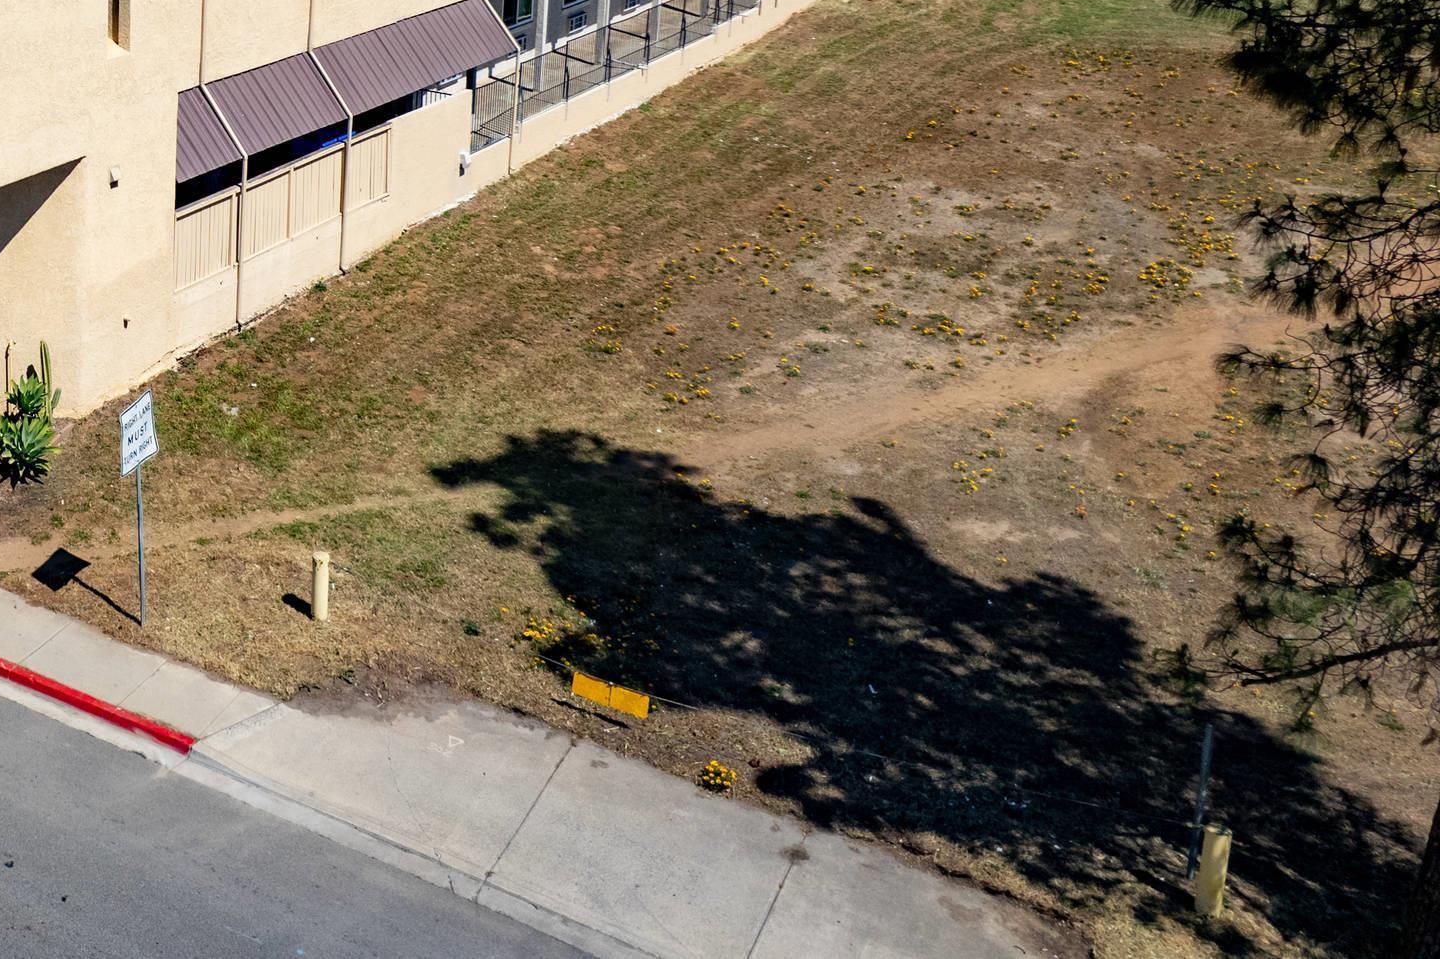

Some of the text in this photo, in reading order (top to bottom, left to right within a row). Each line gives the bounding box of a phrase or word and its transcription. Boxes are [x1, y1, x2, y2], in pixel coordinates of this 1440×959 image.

[124, 402, 151, 431] RIGHT LANE
[127, 421, 148, 446] MUST
[124, 435, 153, 465] TURN RIGHT
